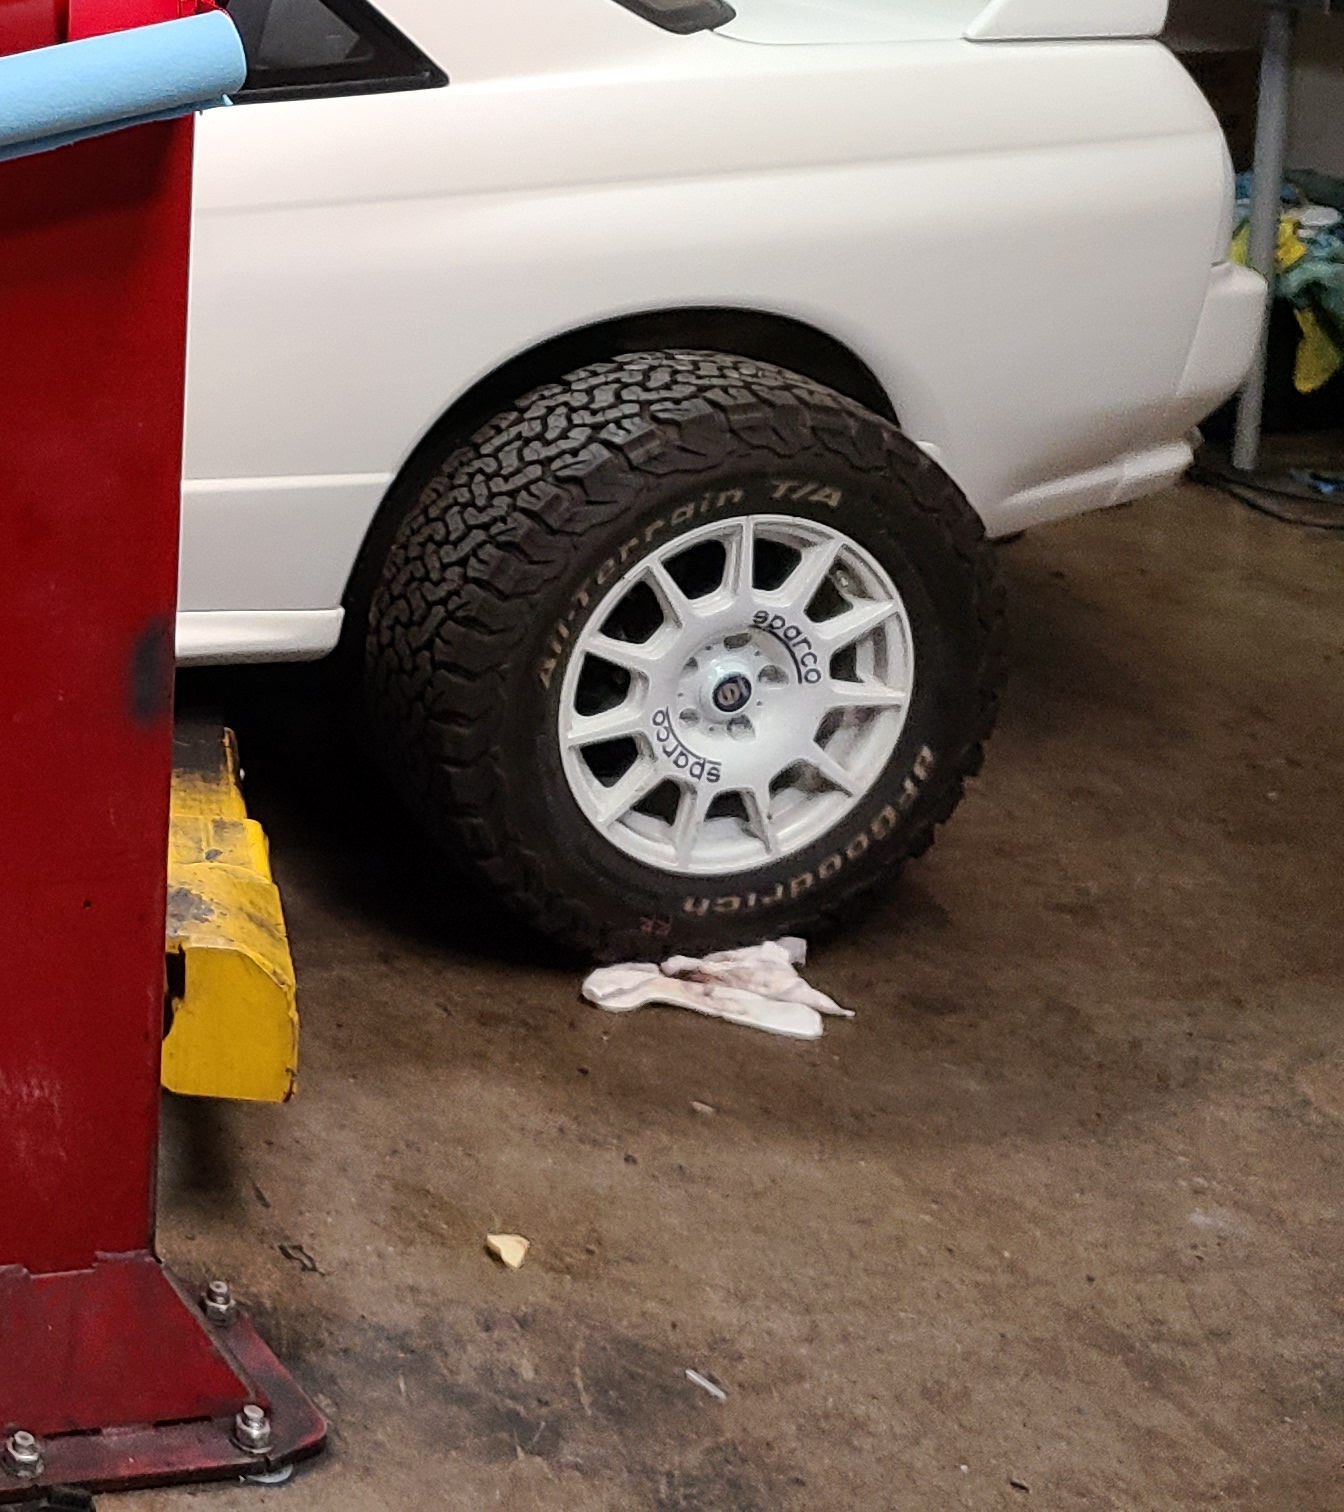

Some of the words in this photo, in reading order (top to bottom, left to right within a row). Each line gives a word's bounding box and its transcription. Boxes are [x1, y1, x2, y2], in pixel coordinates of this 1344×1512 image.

[771, 480, 843, 508] T/A
[750, 610, 822, 685] sparco
[652, 707, 722, 783] sparco
